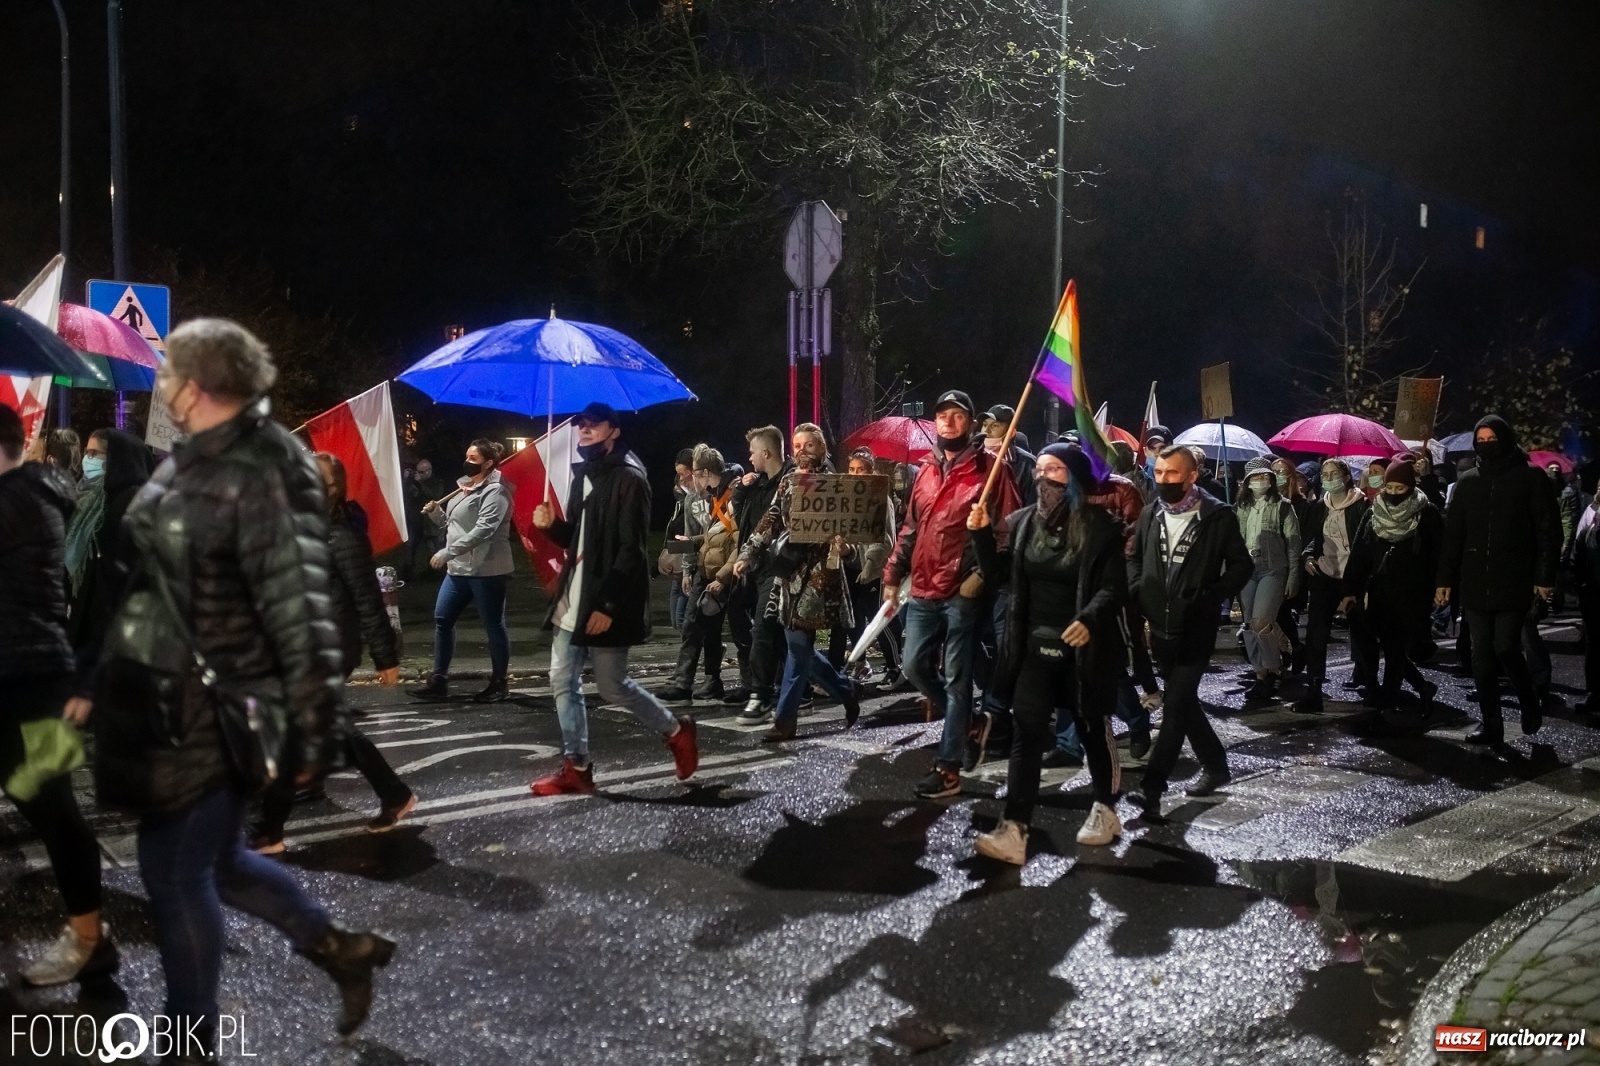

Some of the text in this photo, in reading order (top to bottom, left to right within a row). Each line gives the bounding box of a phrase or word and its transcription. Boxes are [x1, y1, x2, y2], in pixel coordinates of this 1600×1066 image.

[814, 480, 866, 495] ZŁO
[801, 496, 881, 513] DOBREM
[1039, 646, 1064, 657] NASA
